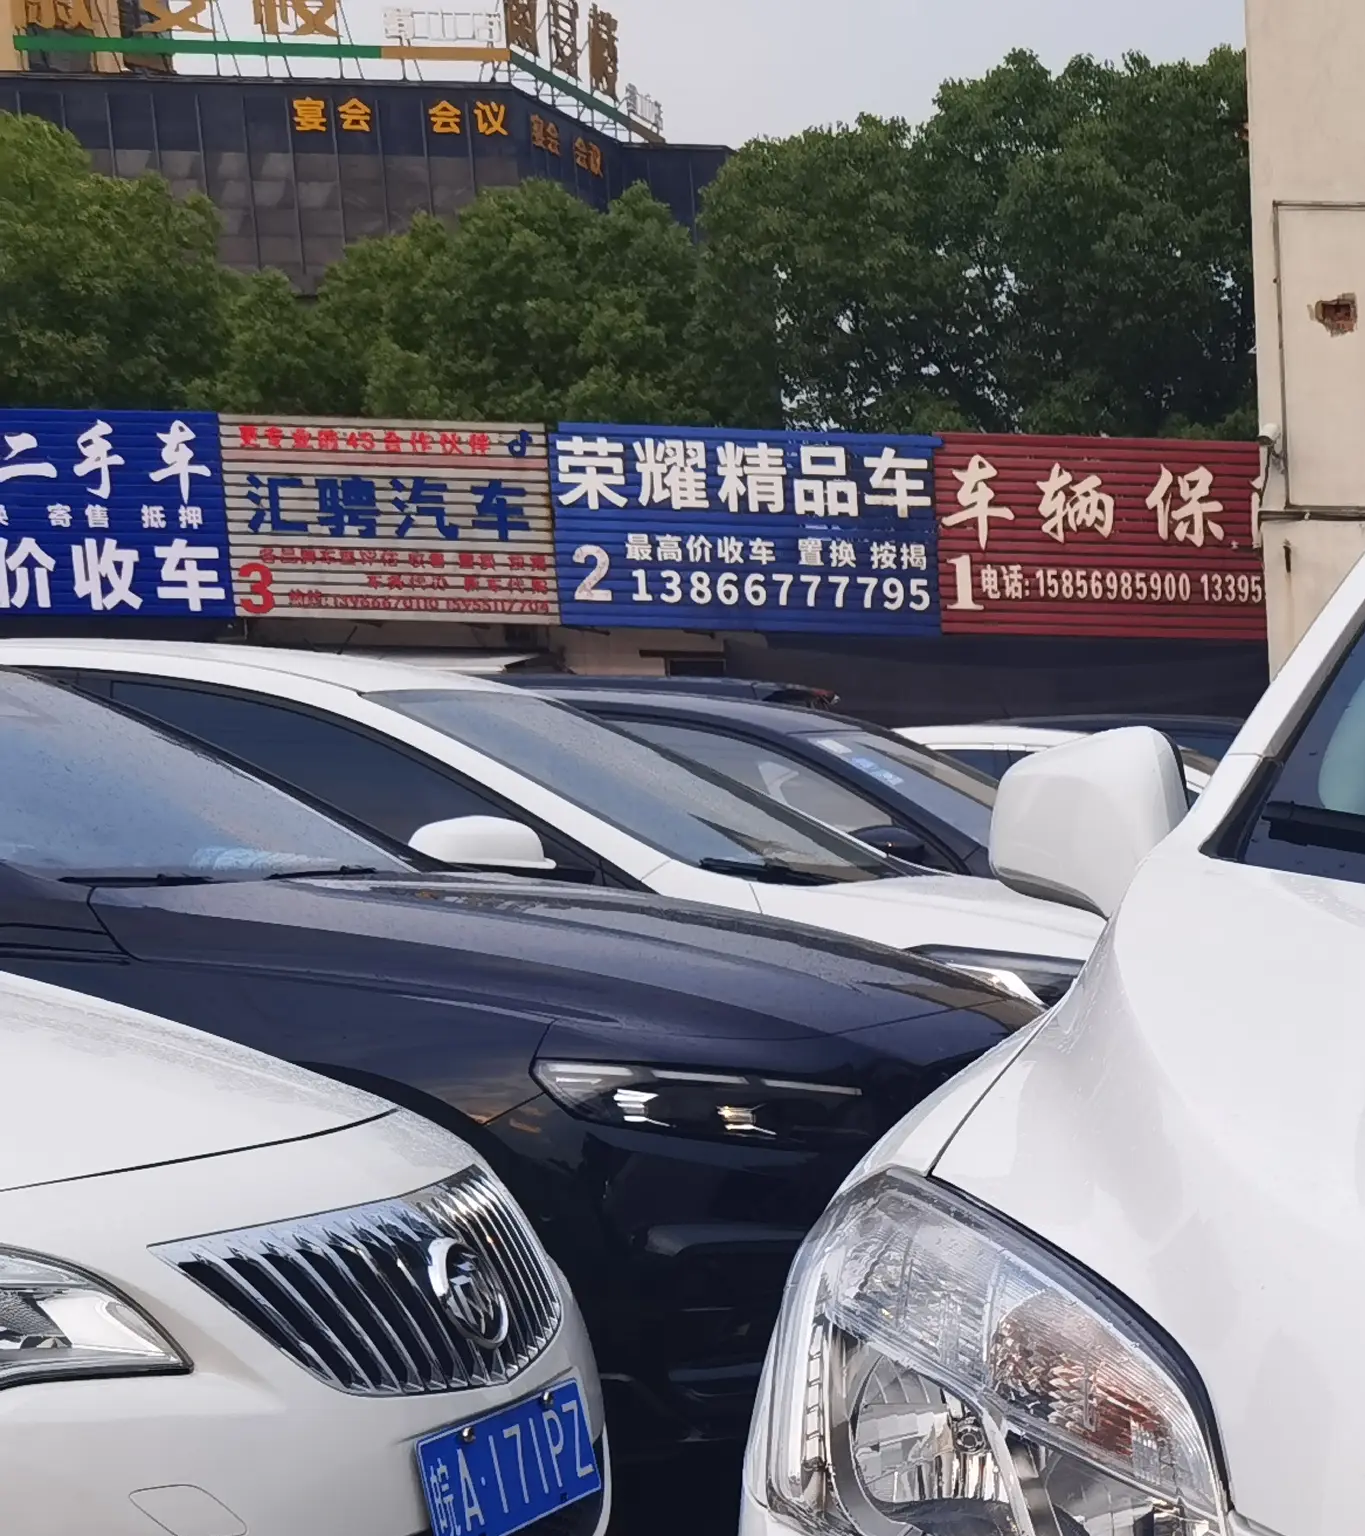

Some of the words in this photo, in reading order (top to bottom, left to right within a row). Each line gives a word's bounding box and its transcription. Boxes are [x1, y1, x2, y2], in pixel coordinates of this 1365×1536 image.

[293, 97, 371, 132] 宴会
[429, 100, 508, 136] 会议
[0, 419, 212, 505] 二手车
[555, 436, 932, 518] 荣耀精品车
[47, 503, 109, 528] 寄售
[141, 504, 204, 529] 抵押
[942, 454, 1262, 550] 车辆保
[0, 537, 226, 611] 价收车
[572, 545, 612, 601] 2
[625, 533, 776, 565] 最高价收车
[798, 538, 857, 569] 置换
[870, 541, 927, 571] 按揭
[238, 563, 274, 613] 3
[631, 569, 931, 611] 13866777795
[946, 554, 985, 610] 1
[1201, 573, 1266, 603] 13395
